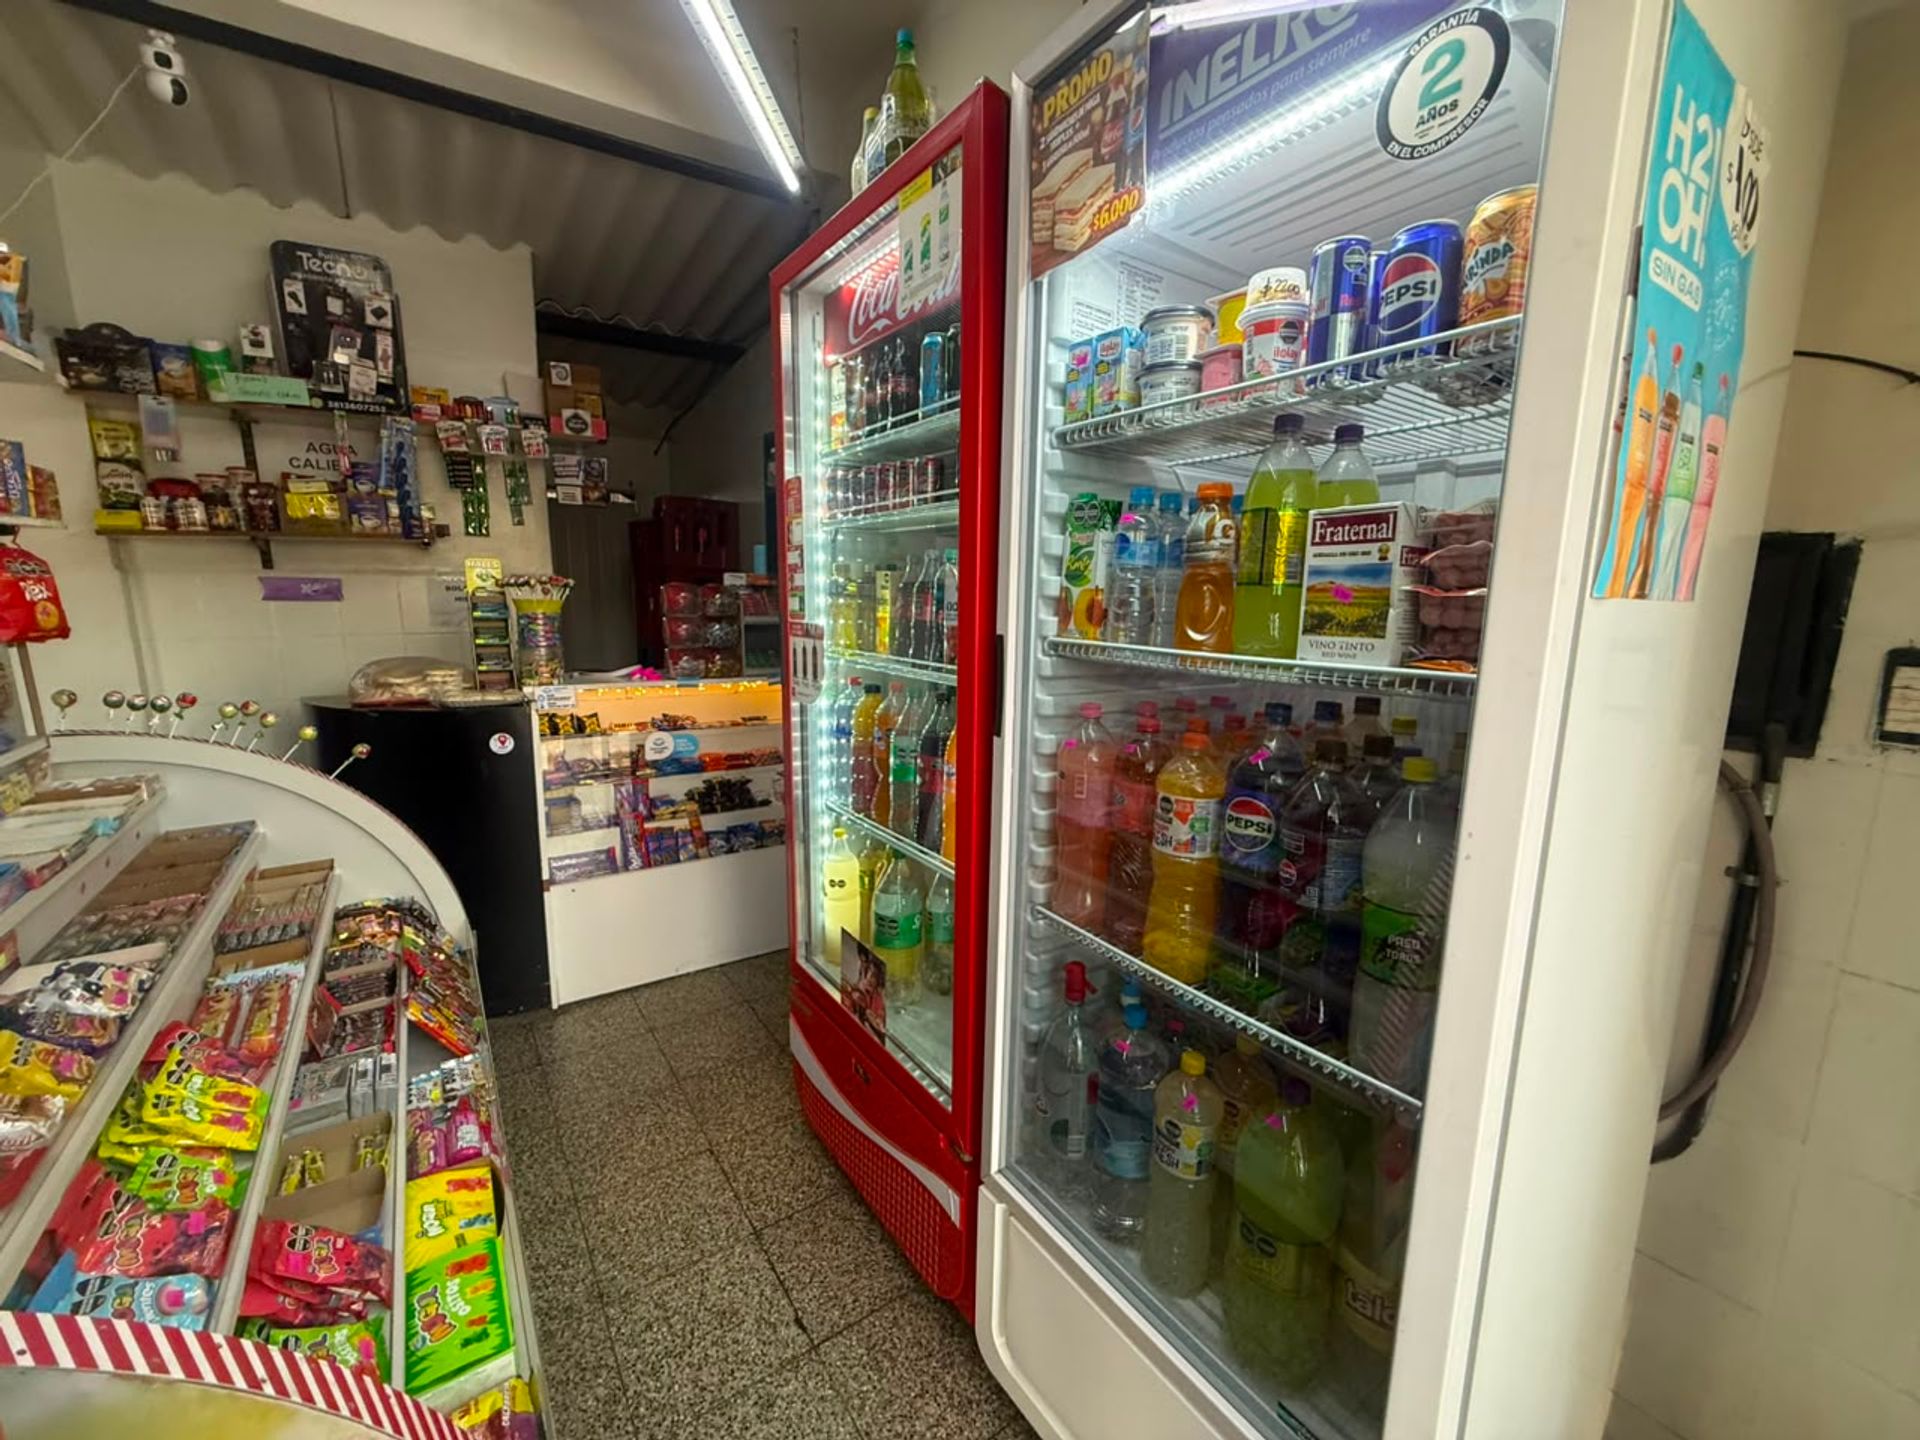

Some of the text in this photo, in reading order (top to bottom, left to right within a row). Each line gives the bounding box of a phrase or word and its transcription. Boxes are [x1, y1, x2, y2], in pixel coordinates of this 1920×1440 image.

[1042, 50, 1113, 129] PROMO
[1417, 37, 1466, 112] 2
[1415, 98, 1460, 130] AÑOS
[1652, 256, 1677, 287] SIN
[1382, 278, 1437, 307] EPSI
[1312, 513, 1394, 544] Fraternal
[1309, 638, 1375, 653] VINO TINTO
[1227, 813, 1273, 835] PEPSI
